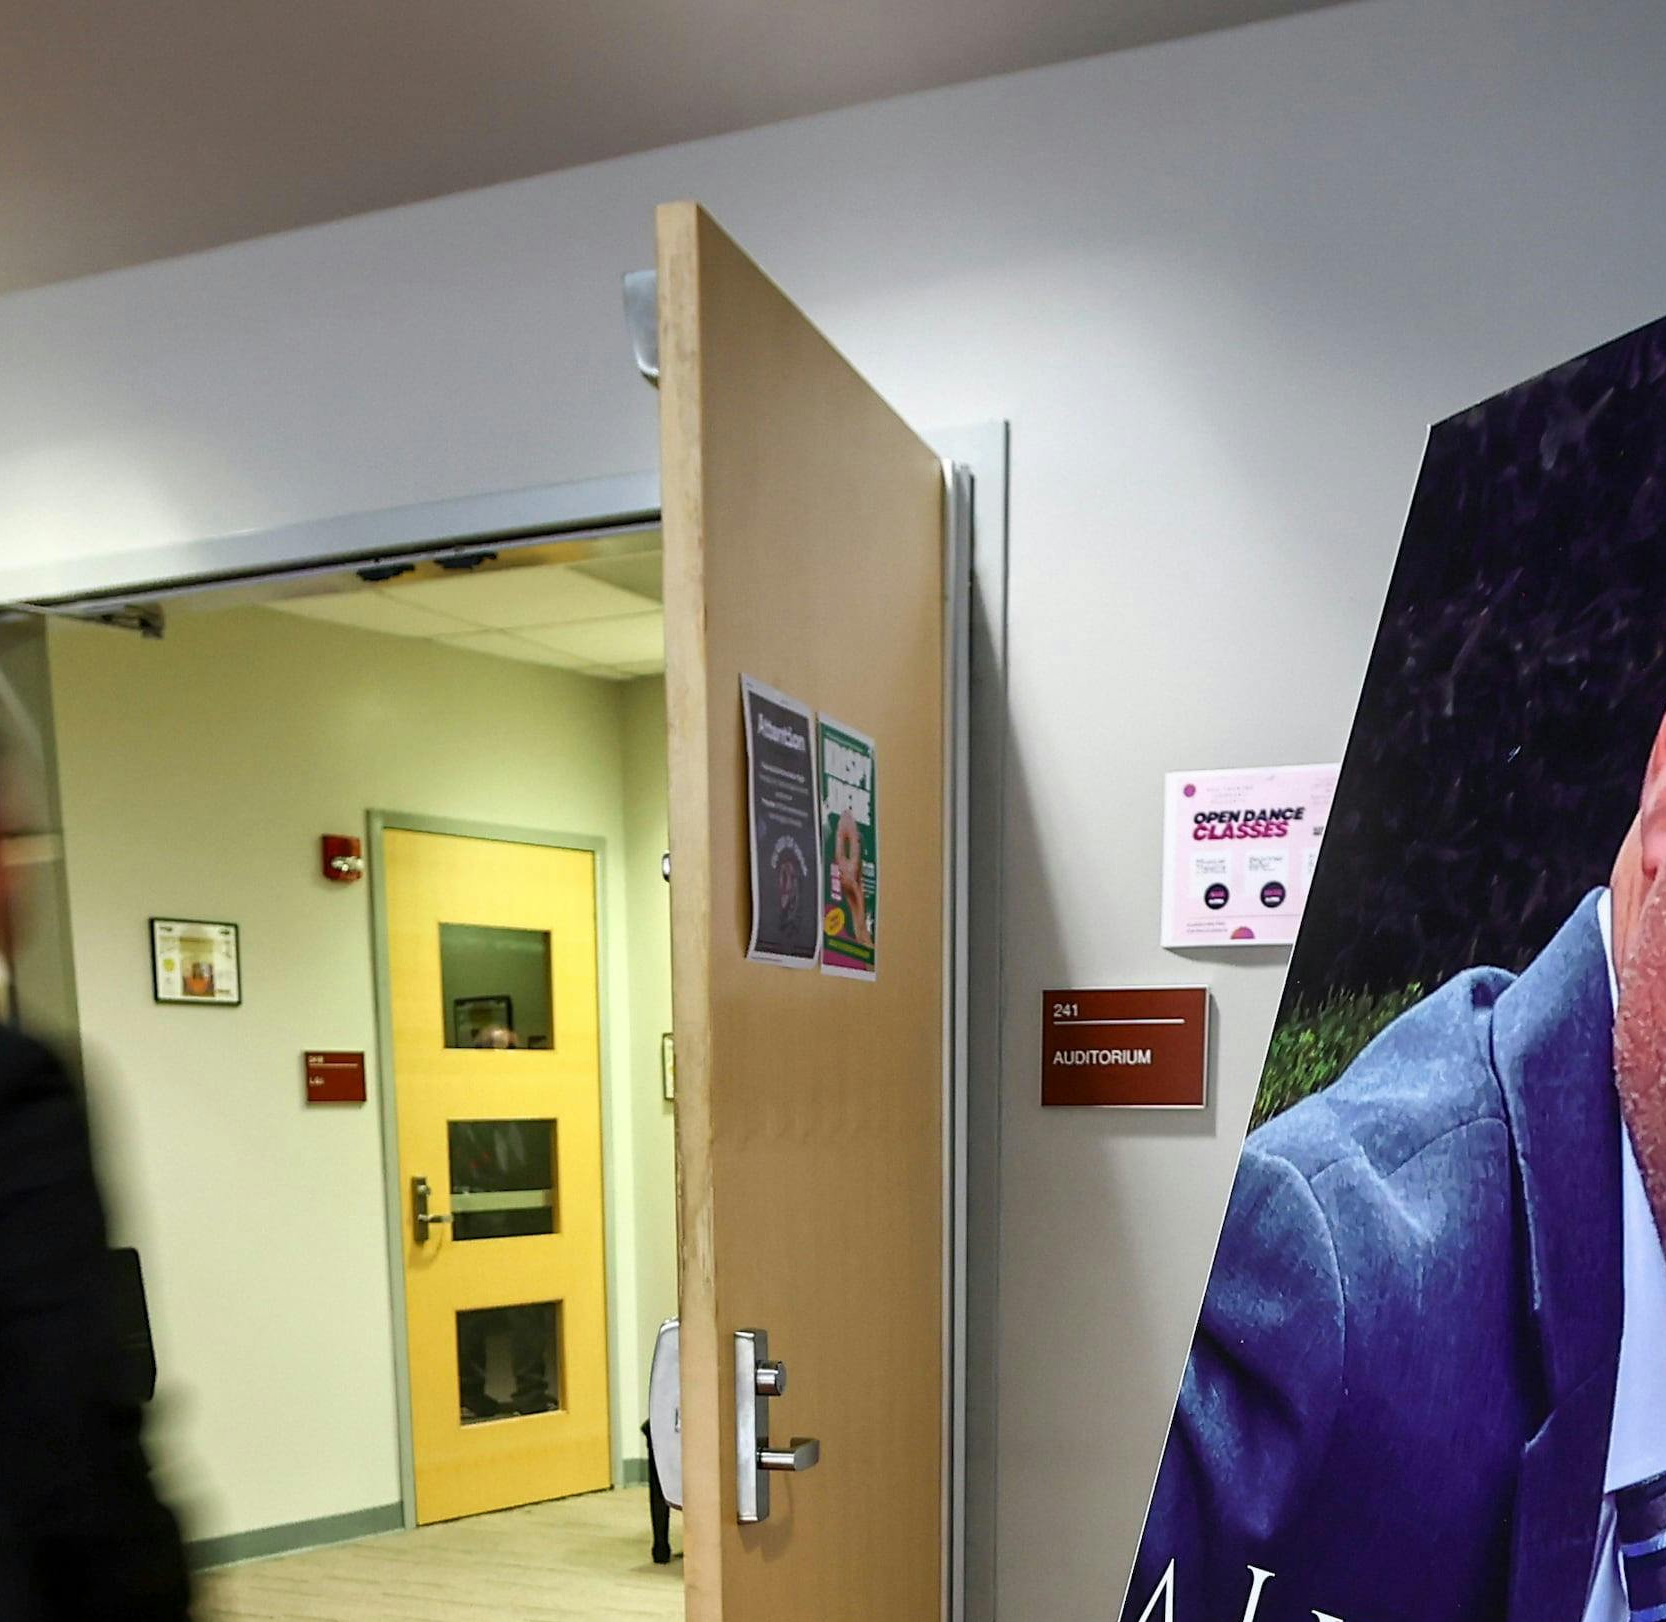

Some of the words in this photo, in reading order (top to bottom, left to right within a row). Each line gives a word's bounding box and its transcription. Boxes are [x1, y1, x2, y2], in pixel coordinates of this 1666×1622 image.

[1193, 810, 1241, 824] OPEN
[1243, 807, 1305, 822] DANCE
[1193, 820, 1288, 840] CLASSES
[1053, 1003, 1078, 1018] 241
[1052, 1049, 1152, 1065] AUDITORIUM
